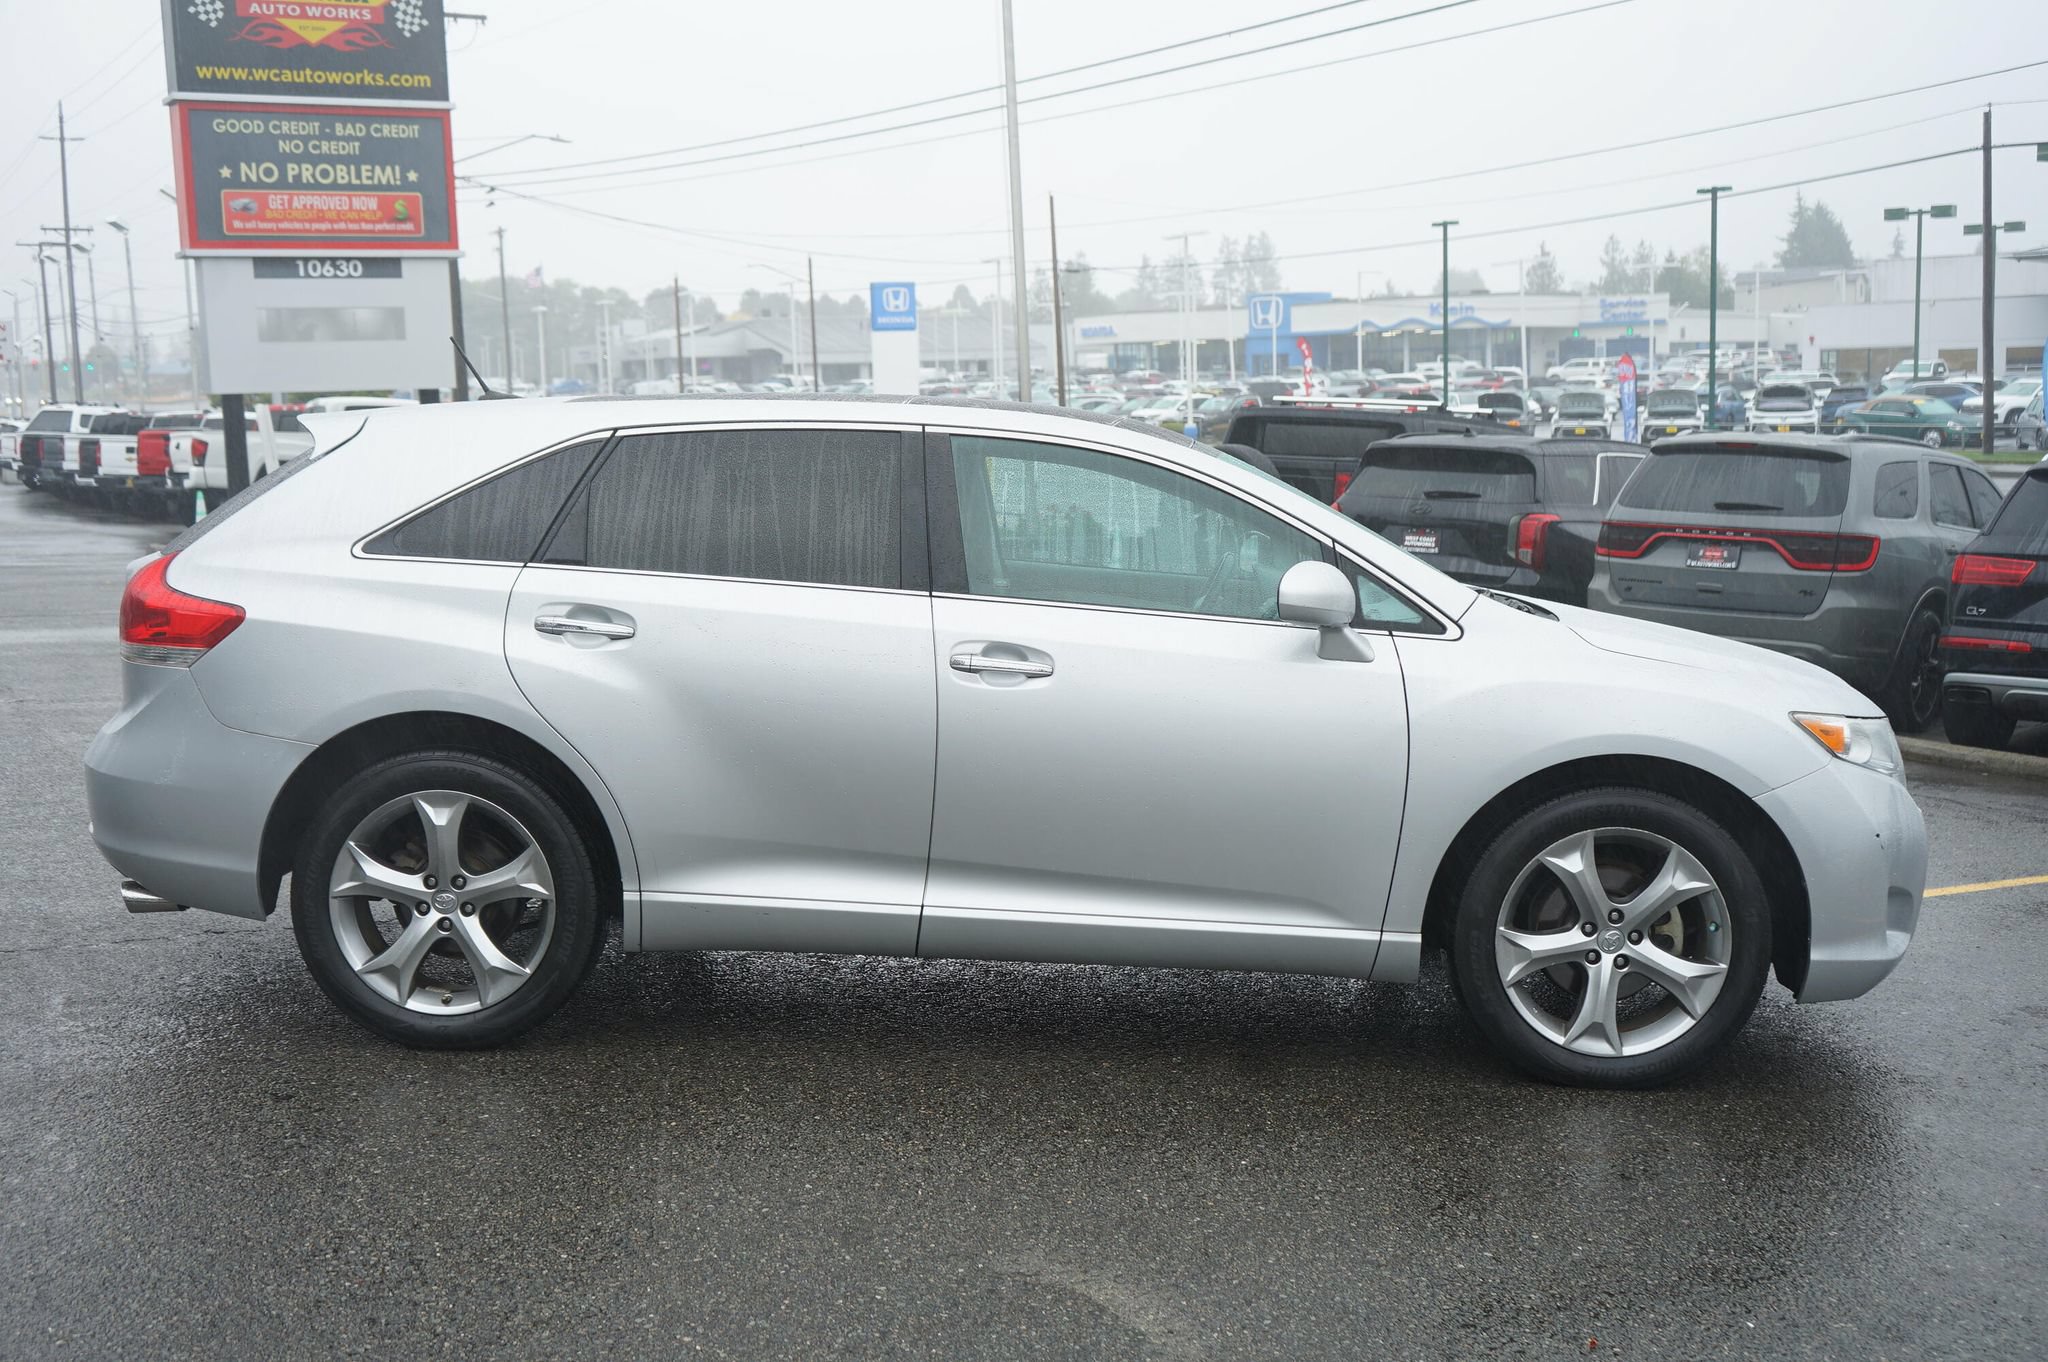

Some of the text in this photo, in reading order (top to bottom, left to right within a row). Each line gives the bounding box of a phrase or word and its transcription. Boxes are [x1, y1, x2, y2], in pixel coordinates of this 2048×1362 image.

[250, 3, 372, 20] AUTO WORKS
[196, 65, 432, 88] www.wcautoworks.com
[212, 119, 264, 134] GOOD
[268, 120, 320, 135] CREDIT
[335, 122, 366, 137] BAD
[370, 124, 420, 138] CREDIT
[278, 139, 361, 155] NO CREDIT
[239, 162, 401, 185] NO PROBLEM!
[268, 194, 378, 211] GET APPROVED NOW
[296, 259, 363, 277] 10630
[1429, 302, 1475, 317] Kein
[1966, 606, 1987, 615] Q7
